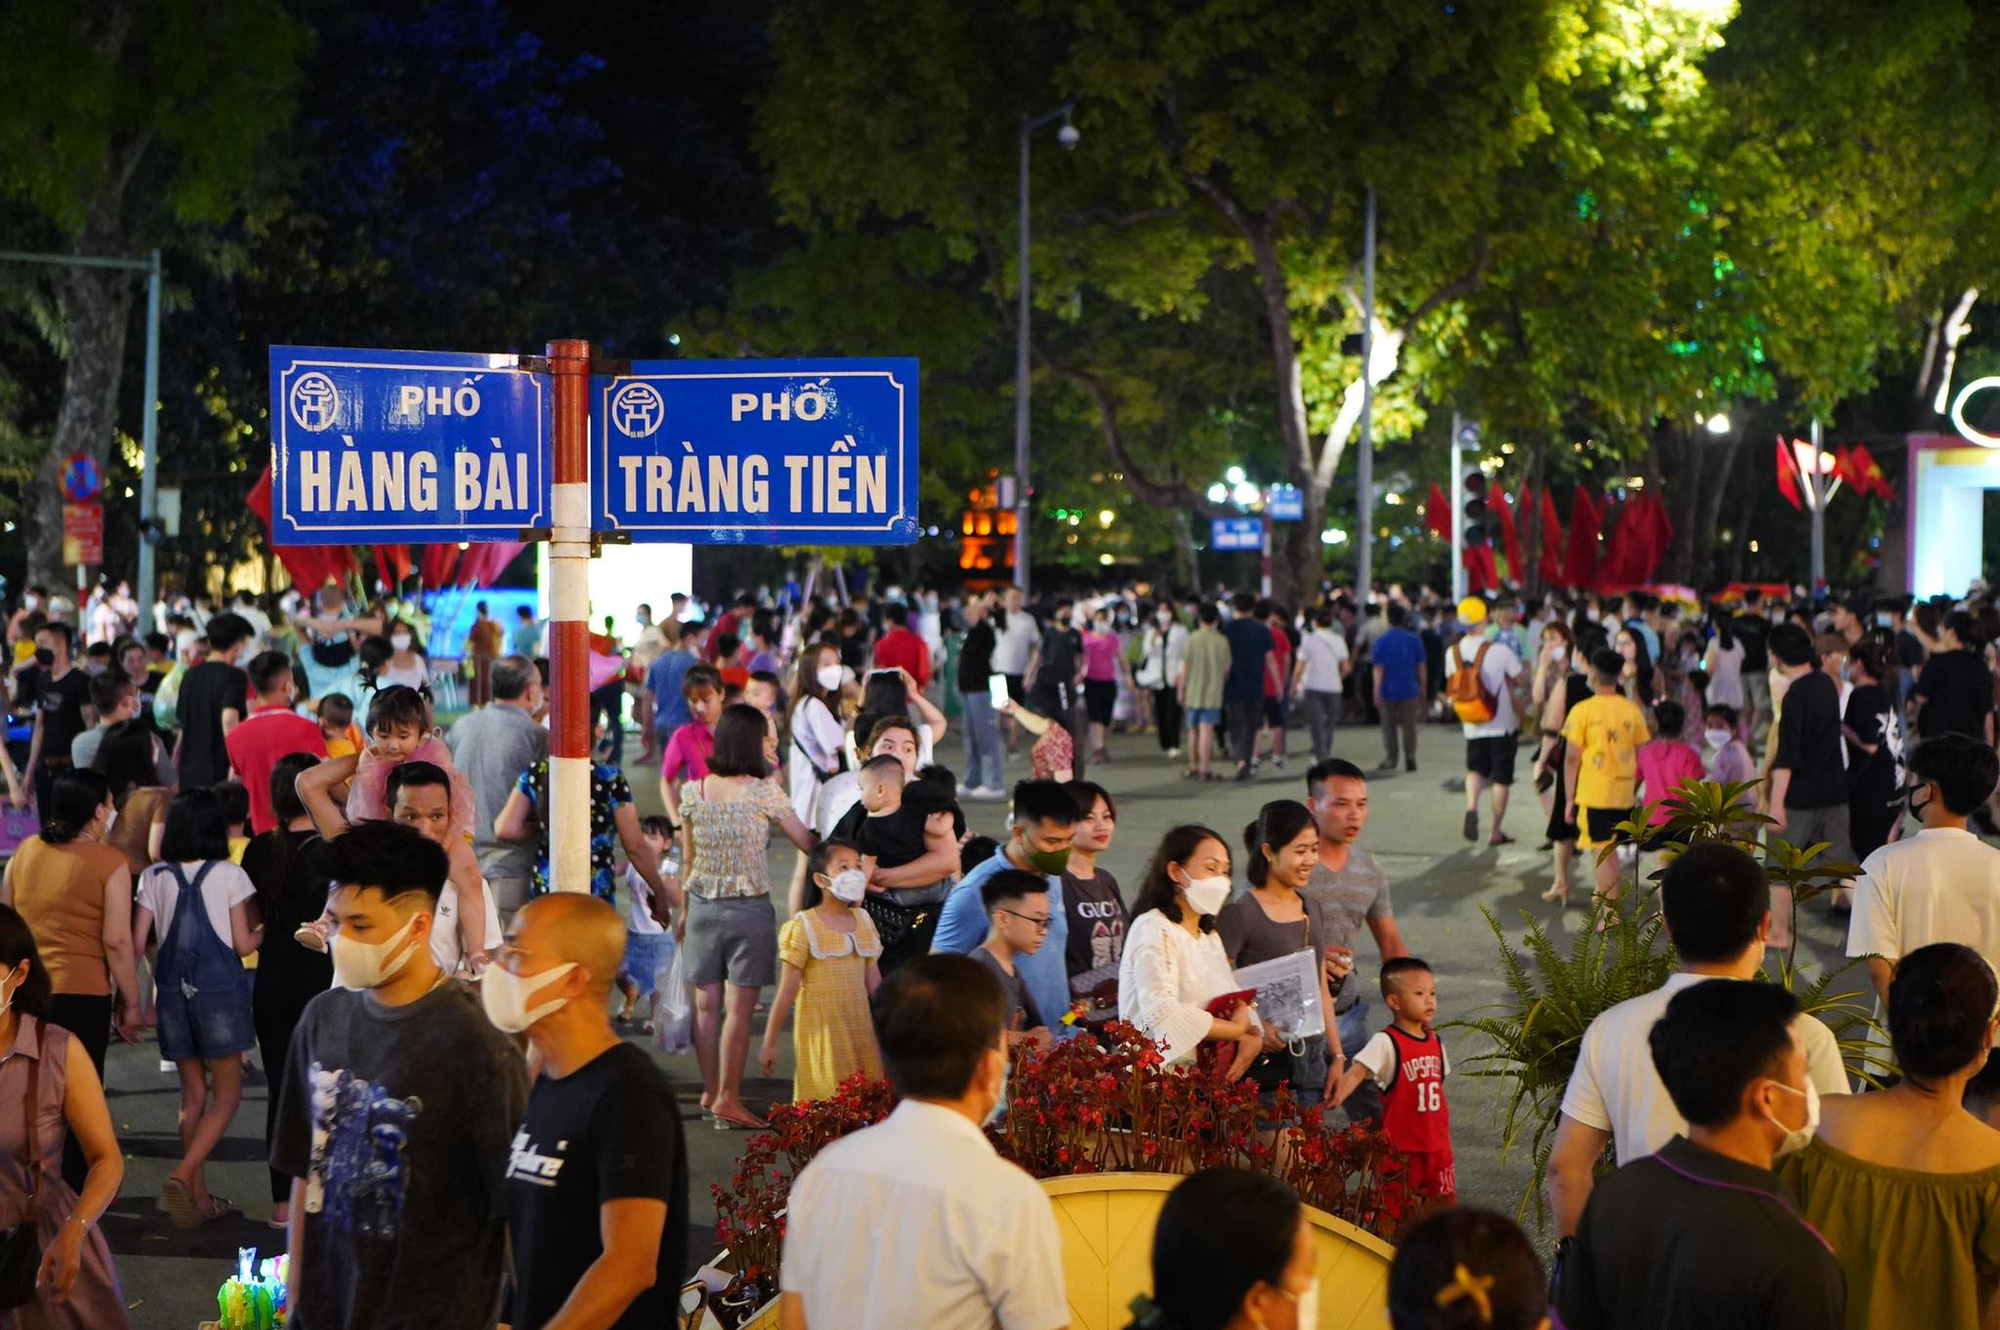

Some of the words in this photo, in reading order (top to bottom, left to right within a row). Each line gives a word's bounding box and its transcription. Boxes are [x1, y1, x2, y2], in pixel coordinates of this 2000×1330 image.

[401, 375, 483, 417] PHỐ
[731, 378, 830, 422] PHỐ
[300, 434, 439, 512] HÀNG
[454, 437, 529, 511] BÀI
[618, 441, 770, 514] TRÀNG
[784, 434, 887, 514] TIỀN
[1417, 1082, 1440, 1112] 16
